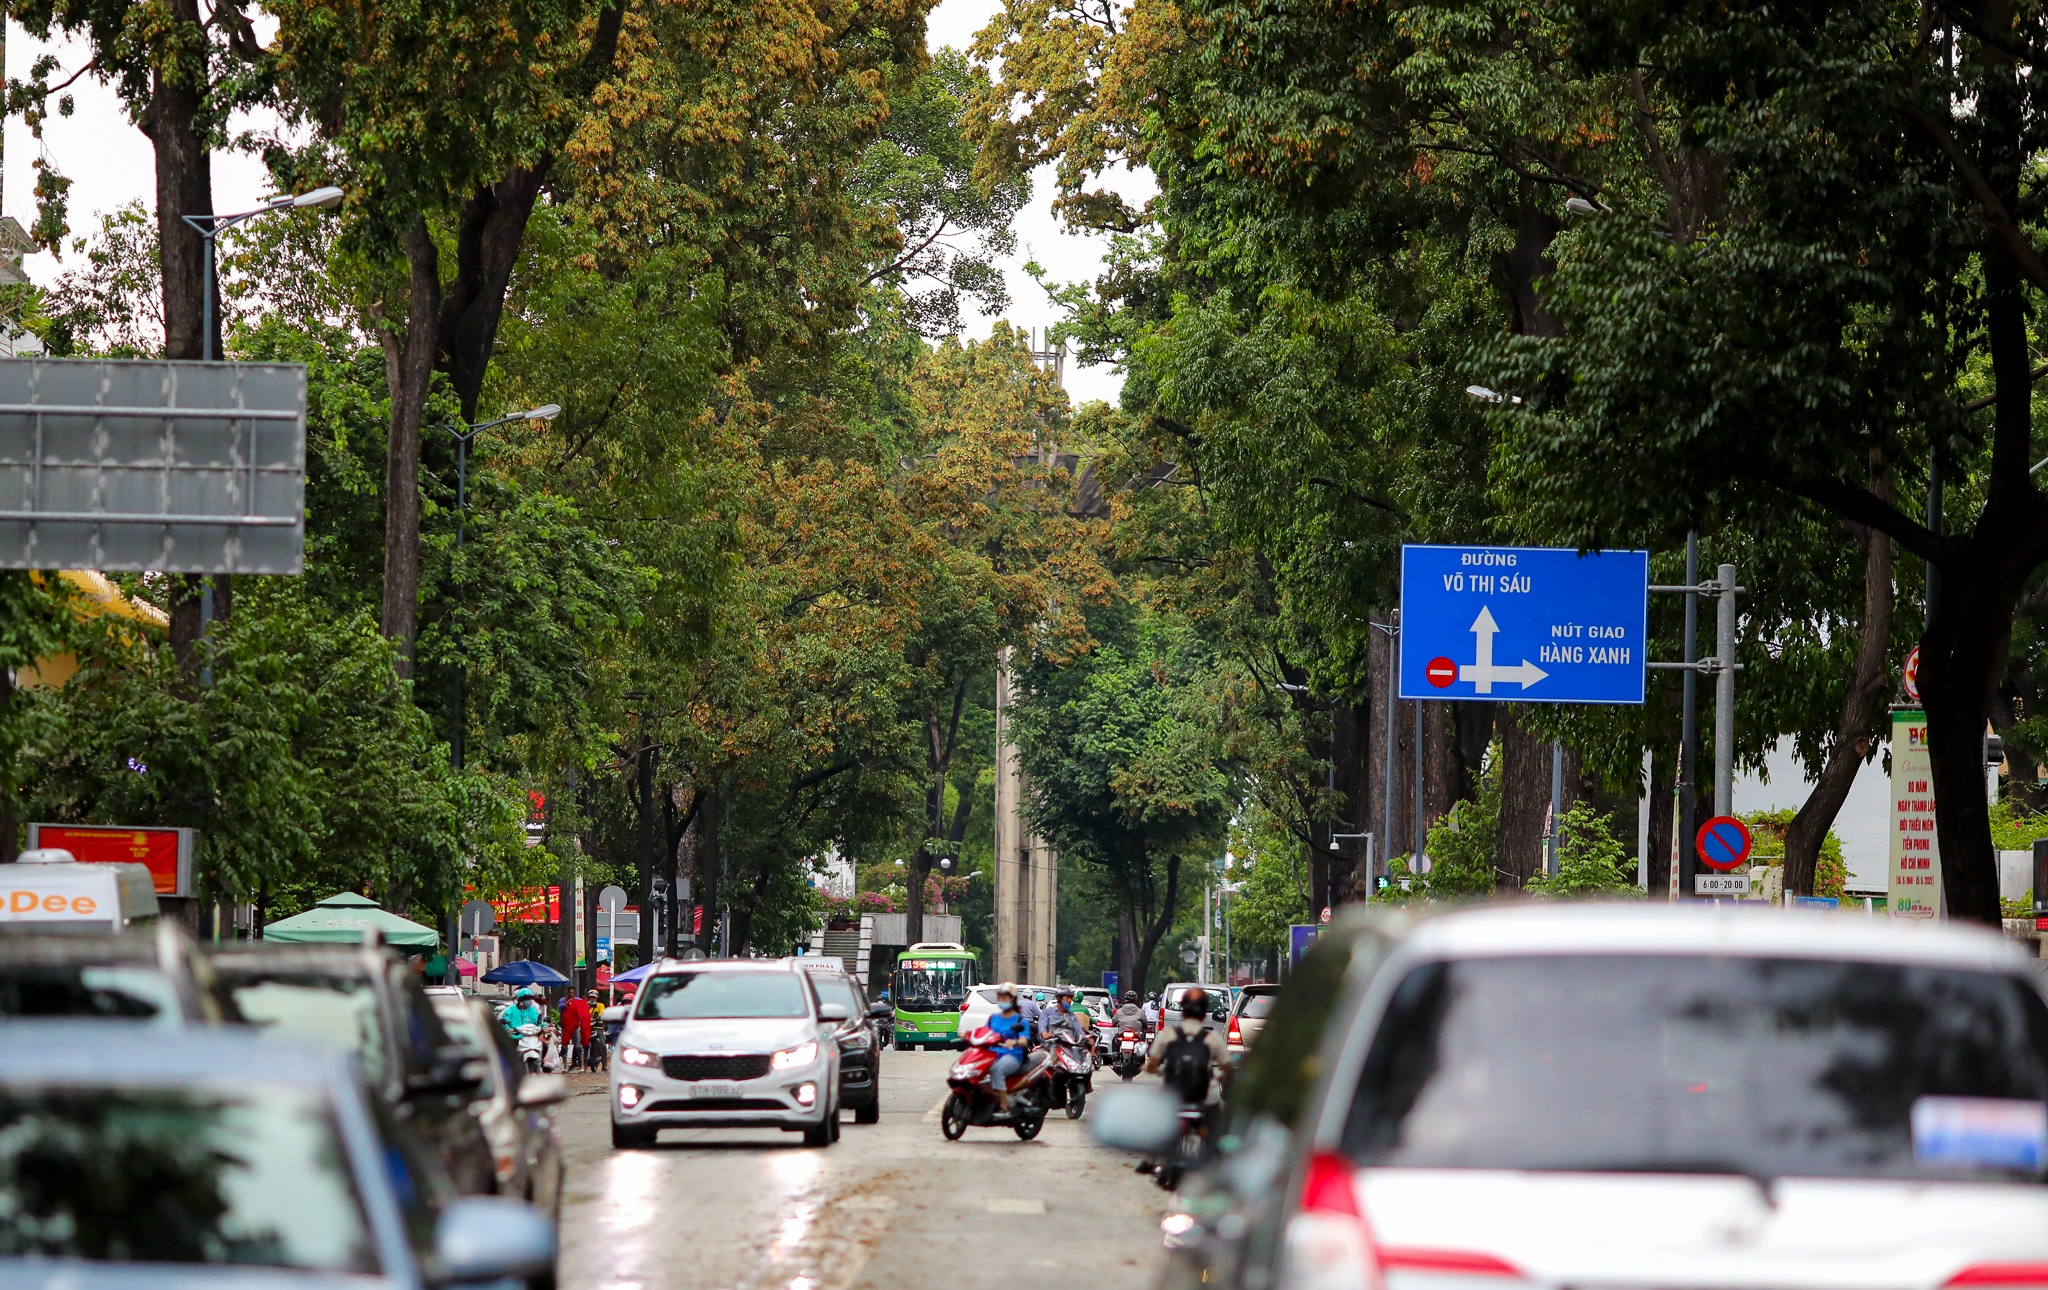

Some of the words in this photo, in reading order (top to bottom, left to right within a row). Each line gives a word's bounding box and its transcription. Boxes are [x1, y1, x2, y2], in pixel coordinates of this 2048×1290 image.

[1461, 551, 1517, 566] ĐƯỜNG
[1443, 572, 1464, 592] VÕ
[1469, 574, 1495, 595] THỊ
[1500, 572, 1531, 593] SÁU
[1551, 622, 1583, 638] NÚT
[1588, 626, 1625, 639] GIAO
[1540, 642, 1583, 664] HÀNG
[1587, 647, 1630, 664] XANH
[0, 890, 97, 915] Dee
[1897, 898, 1911, 911] 80
